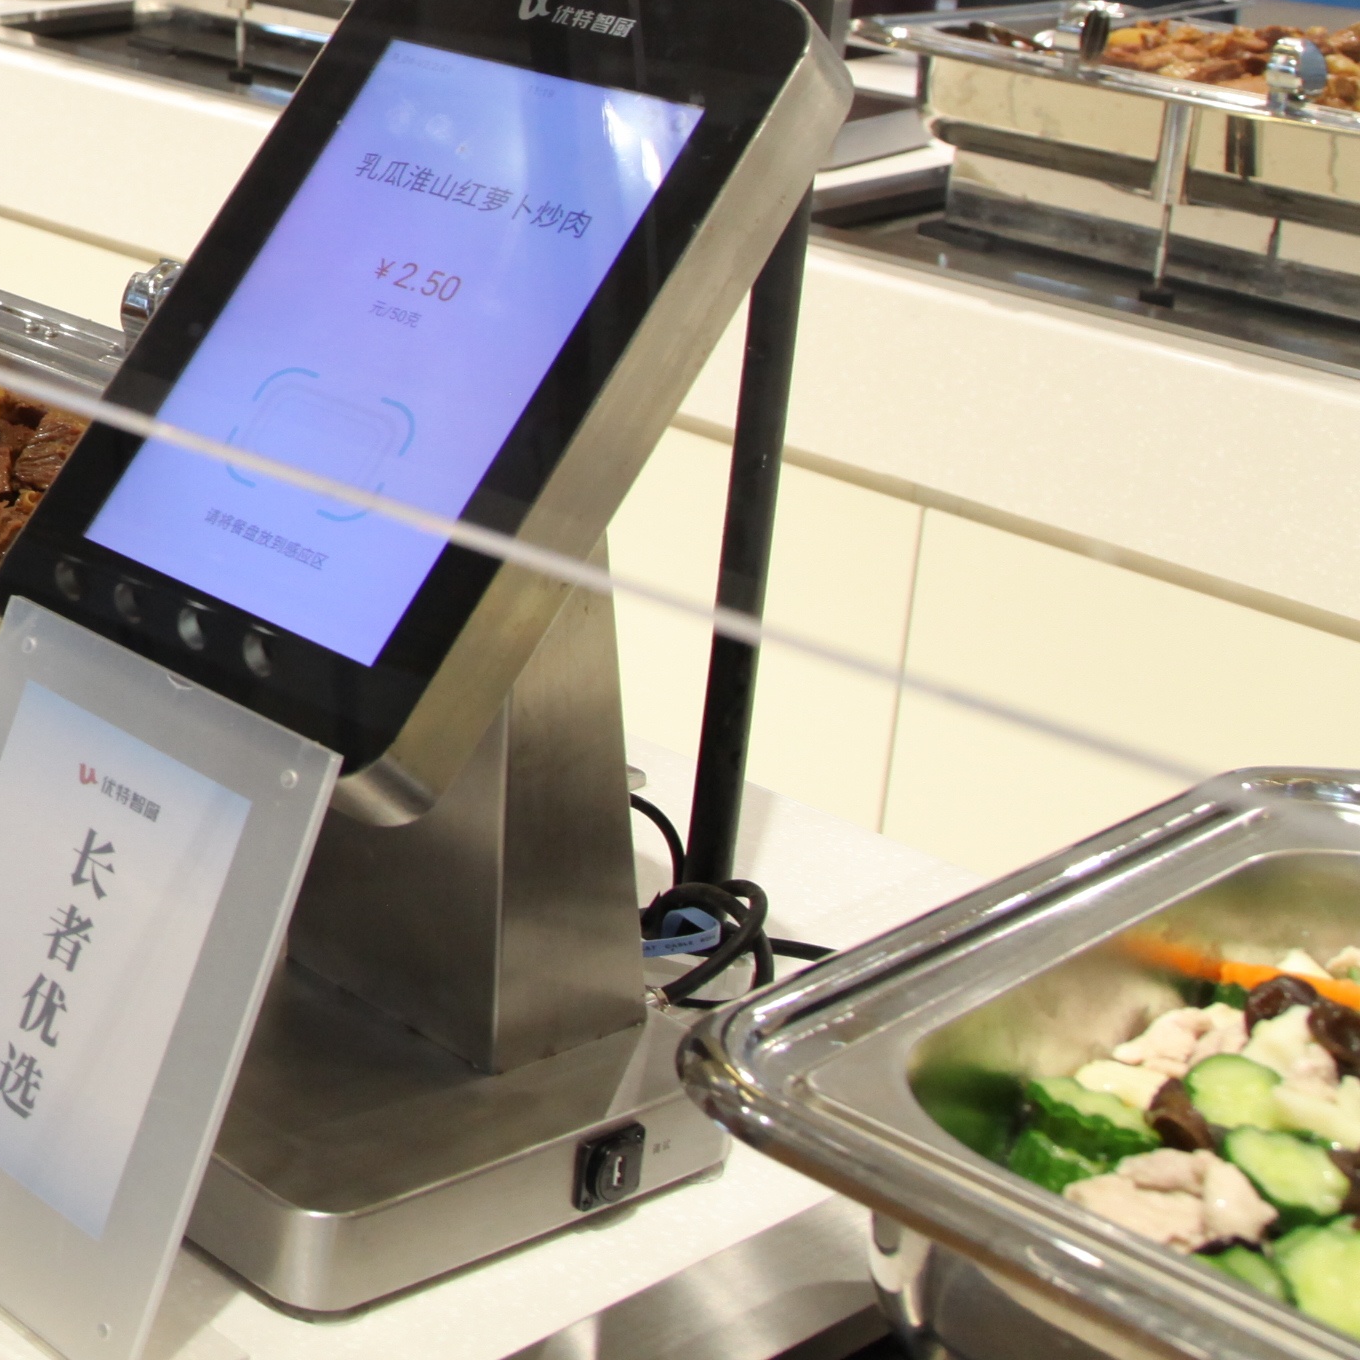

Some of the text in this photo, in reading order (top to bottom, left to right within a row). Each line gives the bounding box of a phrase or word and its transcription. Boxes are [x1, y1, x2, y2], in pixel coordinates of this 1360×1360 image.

[551, 5, 637, 38] 优特智厨
[355, 152, 593, 239] 乳瓜淮山红萝卜炒肉
[101, 775, 161, 823] 优特智厨
